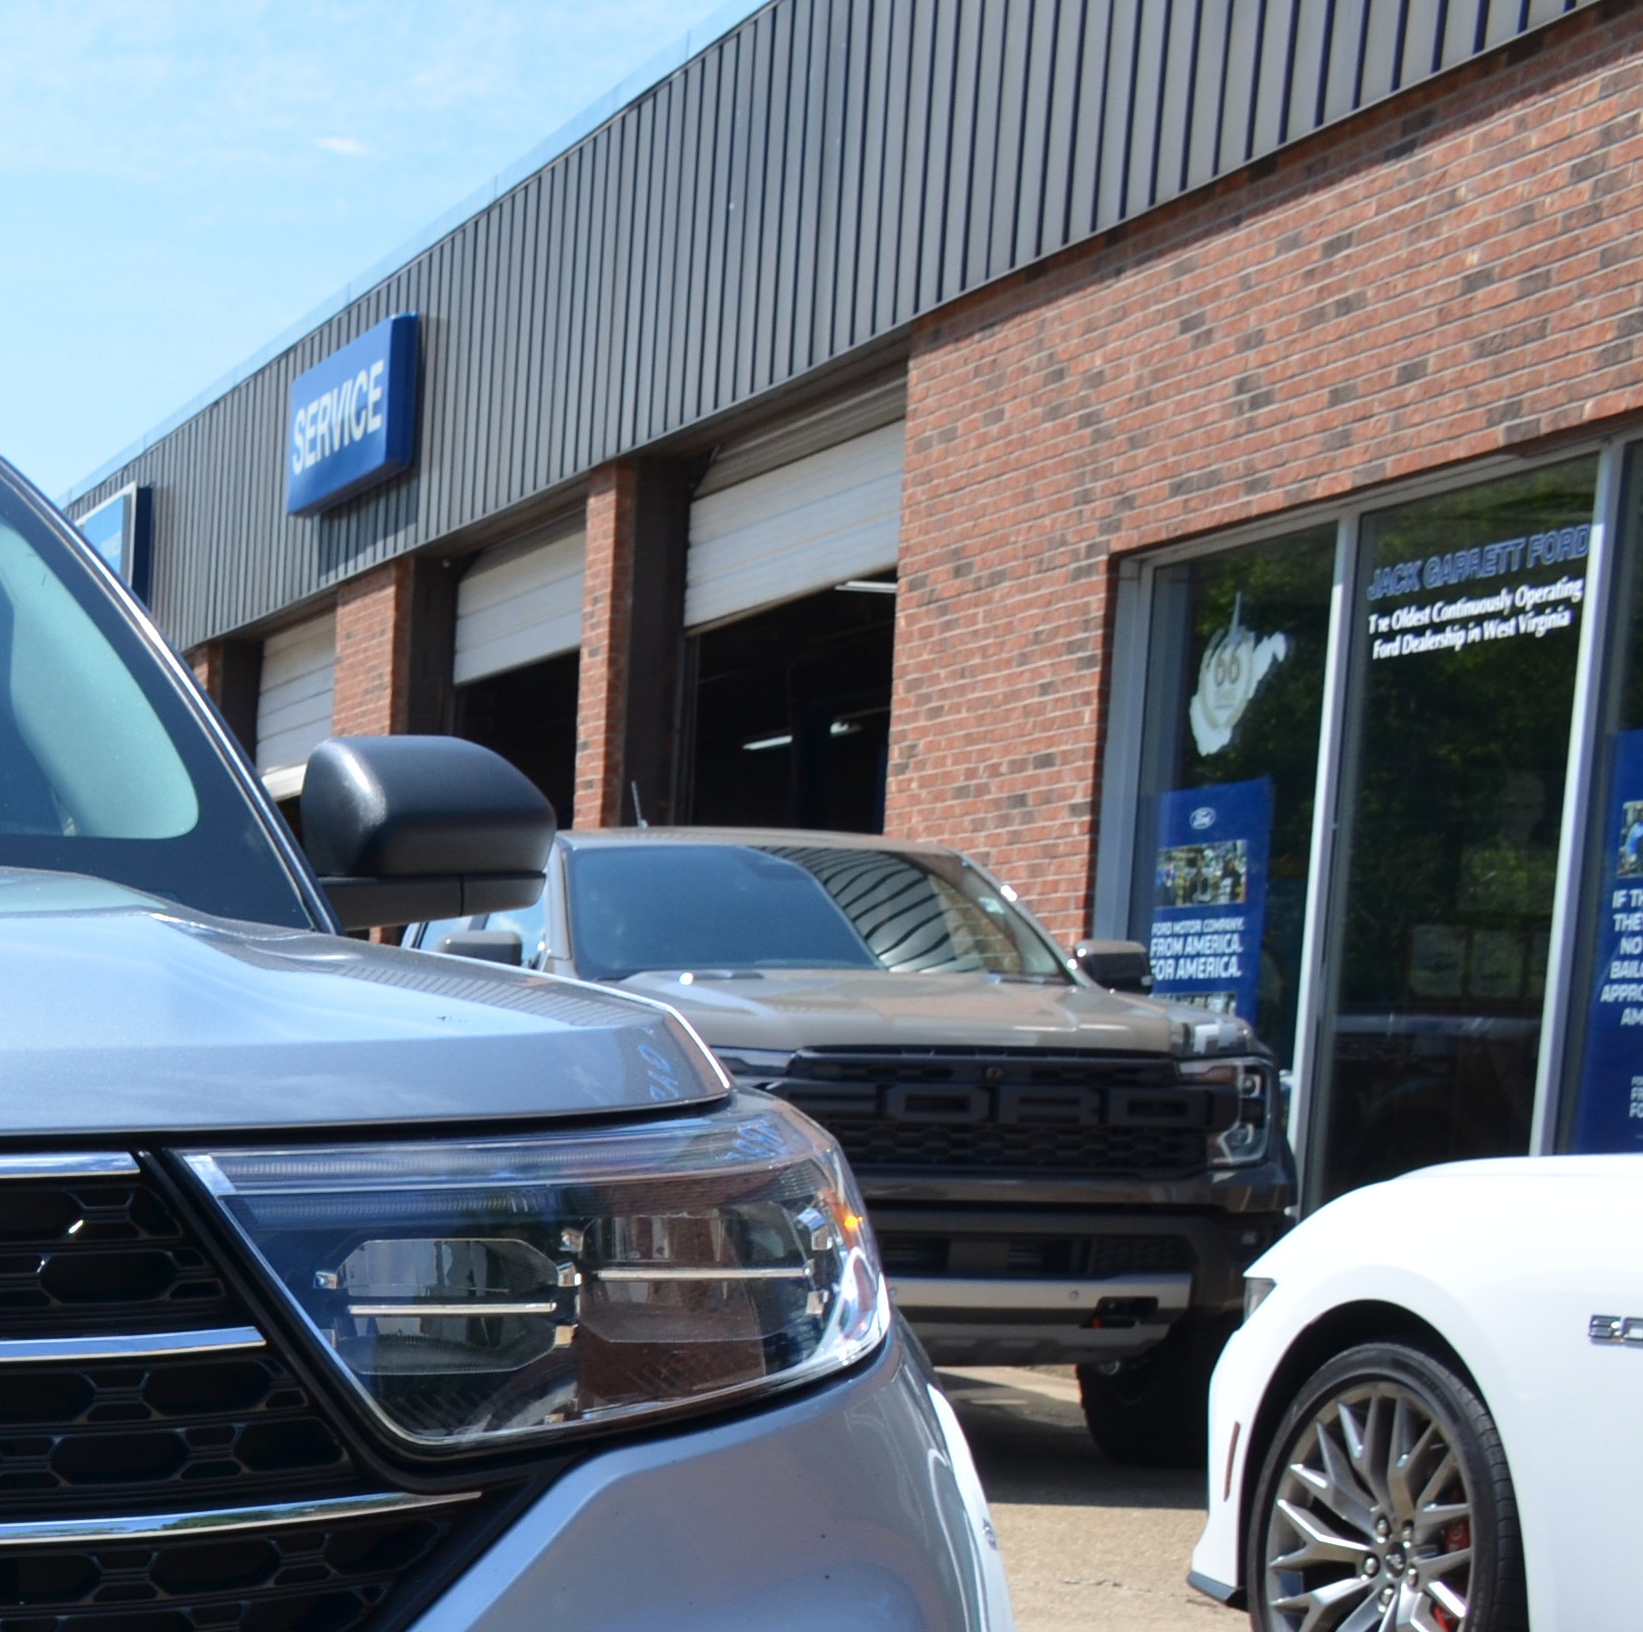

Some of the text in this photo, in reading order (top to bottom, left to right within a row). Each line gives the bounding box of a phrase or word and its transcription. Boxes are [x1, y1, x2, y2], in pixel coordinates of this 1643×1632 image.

[293, 359, 384, 475] SERVICE
[1366, 523, 1590, 600] JACK GARRETT FORD
[1391, 604, 1432, 631] Oldest
[1432, 587, 1514, 623] Continuously
[1515, 575, 1584, 611] Operating
[1372, 604, 1571, 660] Ford Dealership in West Virginia
[1612, 889, 1628, 909] IF
[1151, 921, 1173, 937] FORD
[1173, 919, 1202, 935] MOTOR
[1613, 912, 1643, 932] THE
[1150, 933, 1243, 958] FROM AMERICA.
[1175, 955, 1242, 980] AMERICA.
